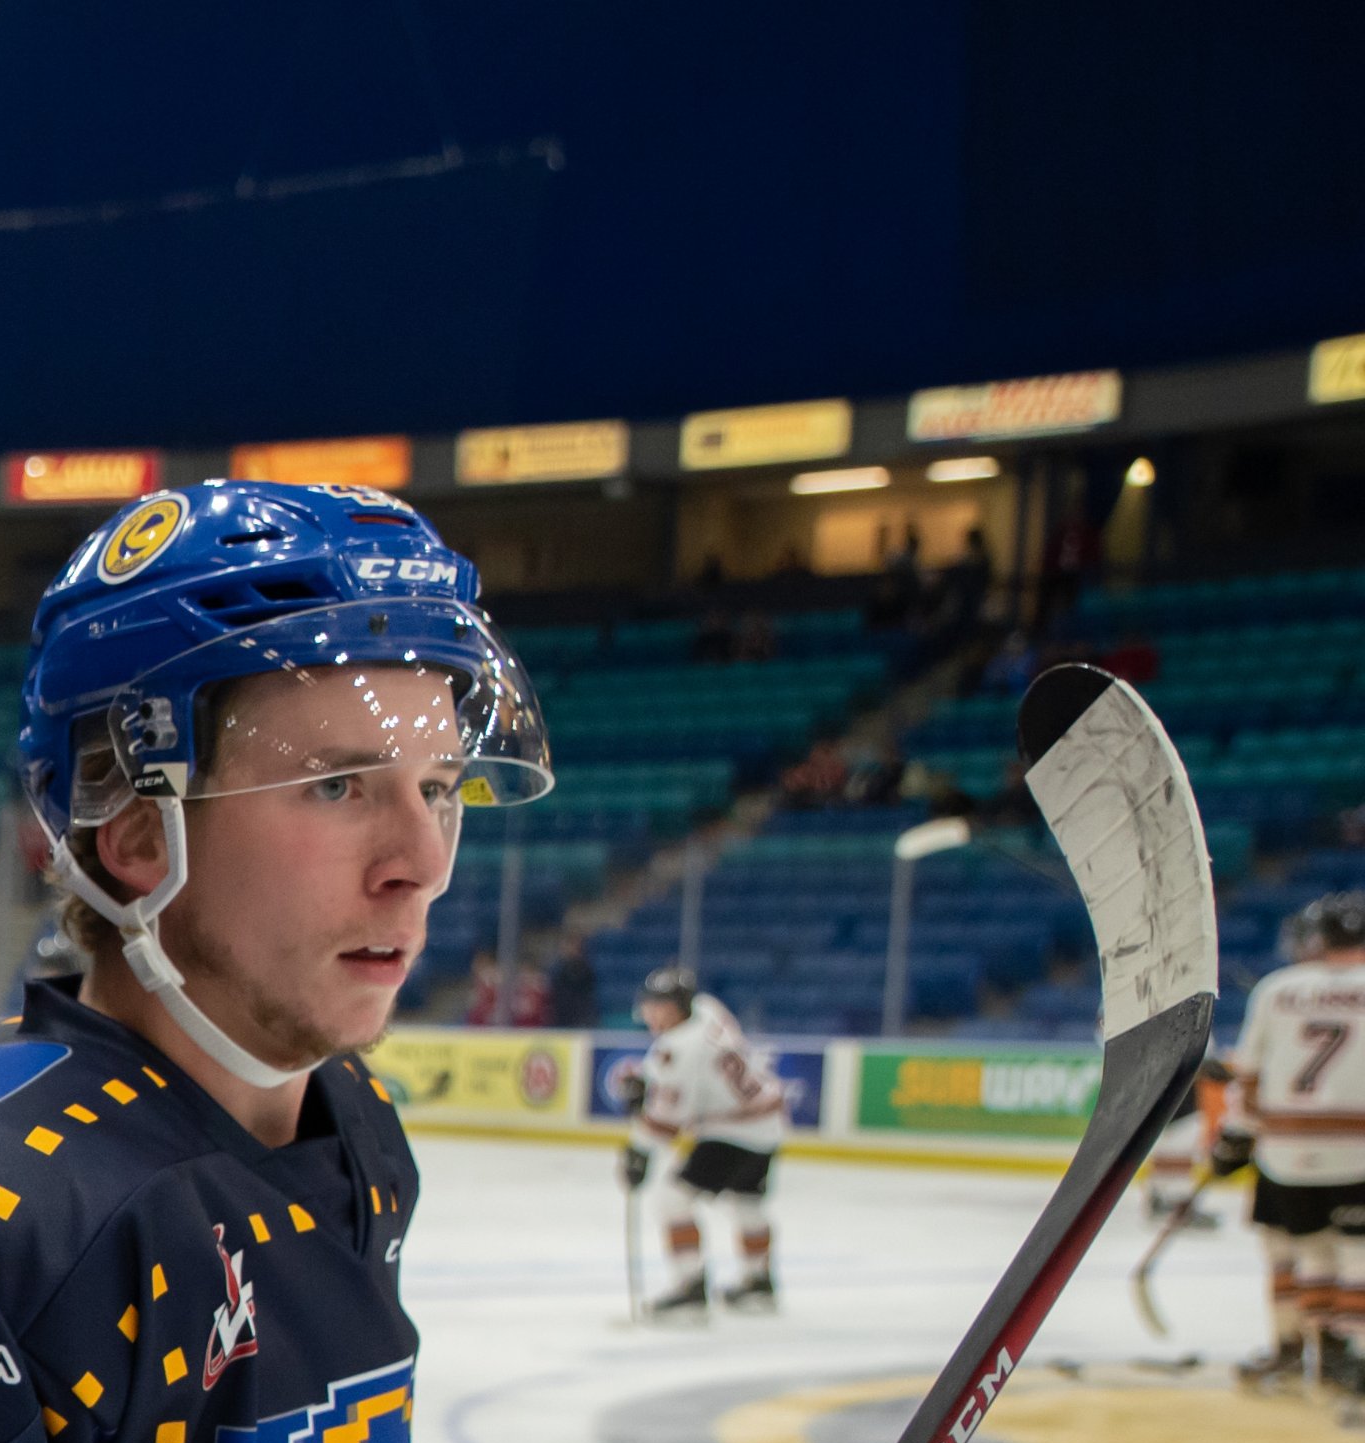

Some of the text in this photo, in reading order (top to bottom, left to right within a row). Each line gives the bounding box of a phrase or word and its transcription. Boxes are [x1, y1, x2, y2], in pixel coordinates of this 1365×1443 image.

[357, 558, 458, 586] CCM
[134, 775, 165, 789] CCM
[1291, 1020, 1349, 1095] 7
